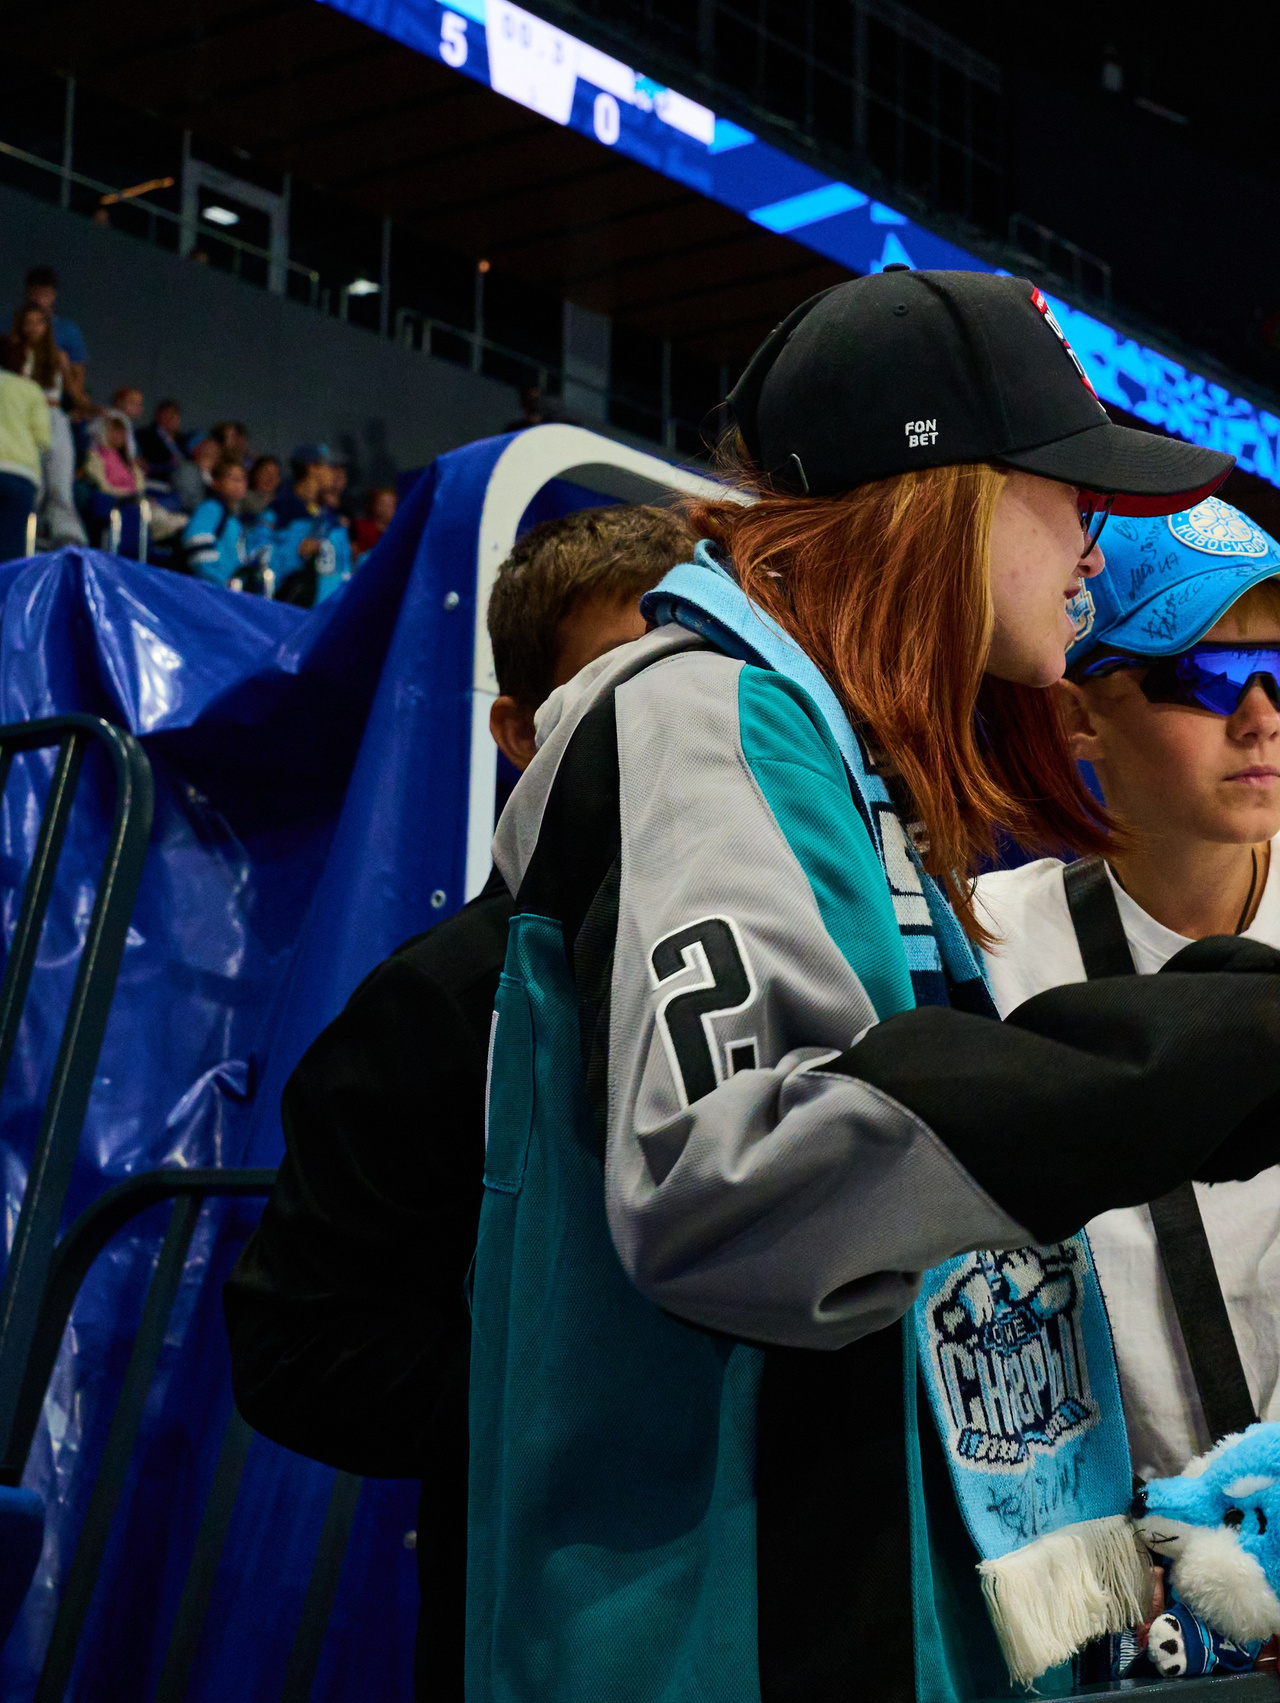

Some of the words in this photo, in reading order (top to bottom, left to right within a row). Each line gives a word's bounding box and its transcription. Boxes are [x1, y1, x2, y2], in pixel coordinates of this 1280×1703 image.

[439, 10, 469, 68] 5
[593, 92, 621, 146] 0
[904, 418, 937, 436] FON
[908, 431, 939, 448] BET
